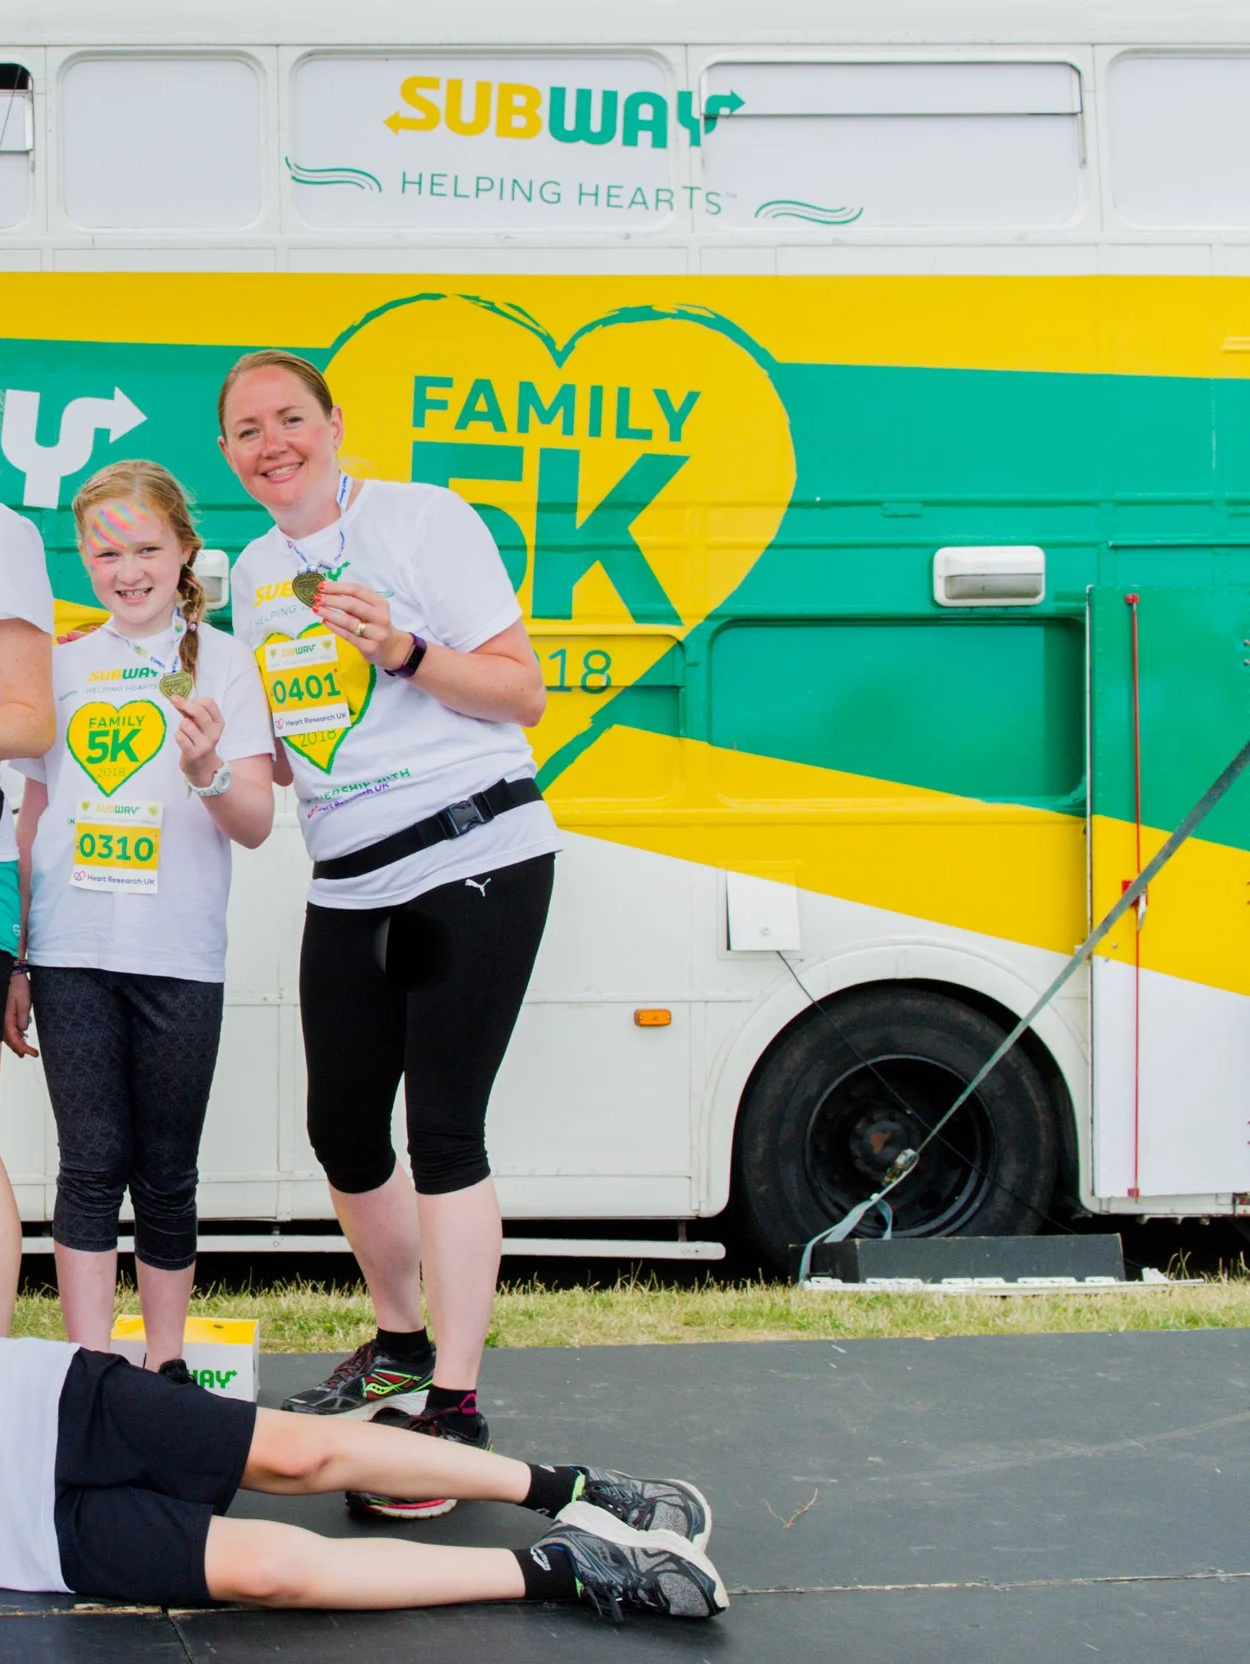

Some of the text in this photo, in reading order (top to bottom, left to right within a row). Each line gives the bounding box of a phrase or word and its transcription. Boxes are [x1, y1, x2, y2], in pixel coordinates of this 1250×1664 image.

[383, 75, 745, 148] SUBWAY
[400, 171, 562, 204] HELPING
[411, 375, 702, 442] FAMILY
[410, 440, 692, 627] 5K
[253, 561, 351, 608] SUBY
[539, 647, 613, 694] 18
[272, 672, 341, 704] 0401
[88, 715, 145, 729] FAMILY
[304, 715, 335, 724] Research
[336, 712, 347, 720] UK
[85, 728, 141, 764] 5K
[96, 767, 126, 778] 2018
[95, 804, 141, 815] SUBWAY
[79, 832, 154, 862] 0310
[86, 873, 106, 882] Heart
[107, 876, 142, 885] Research
